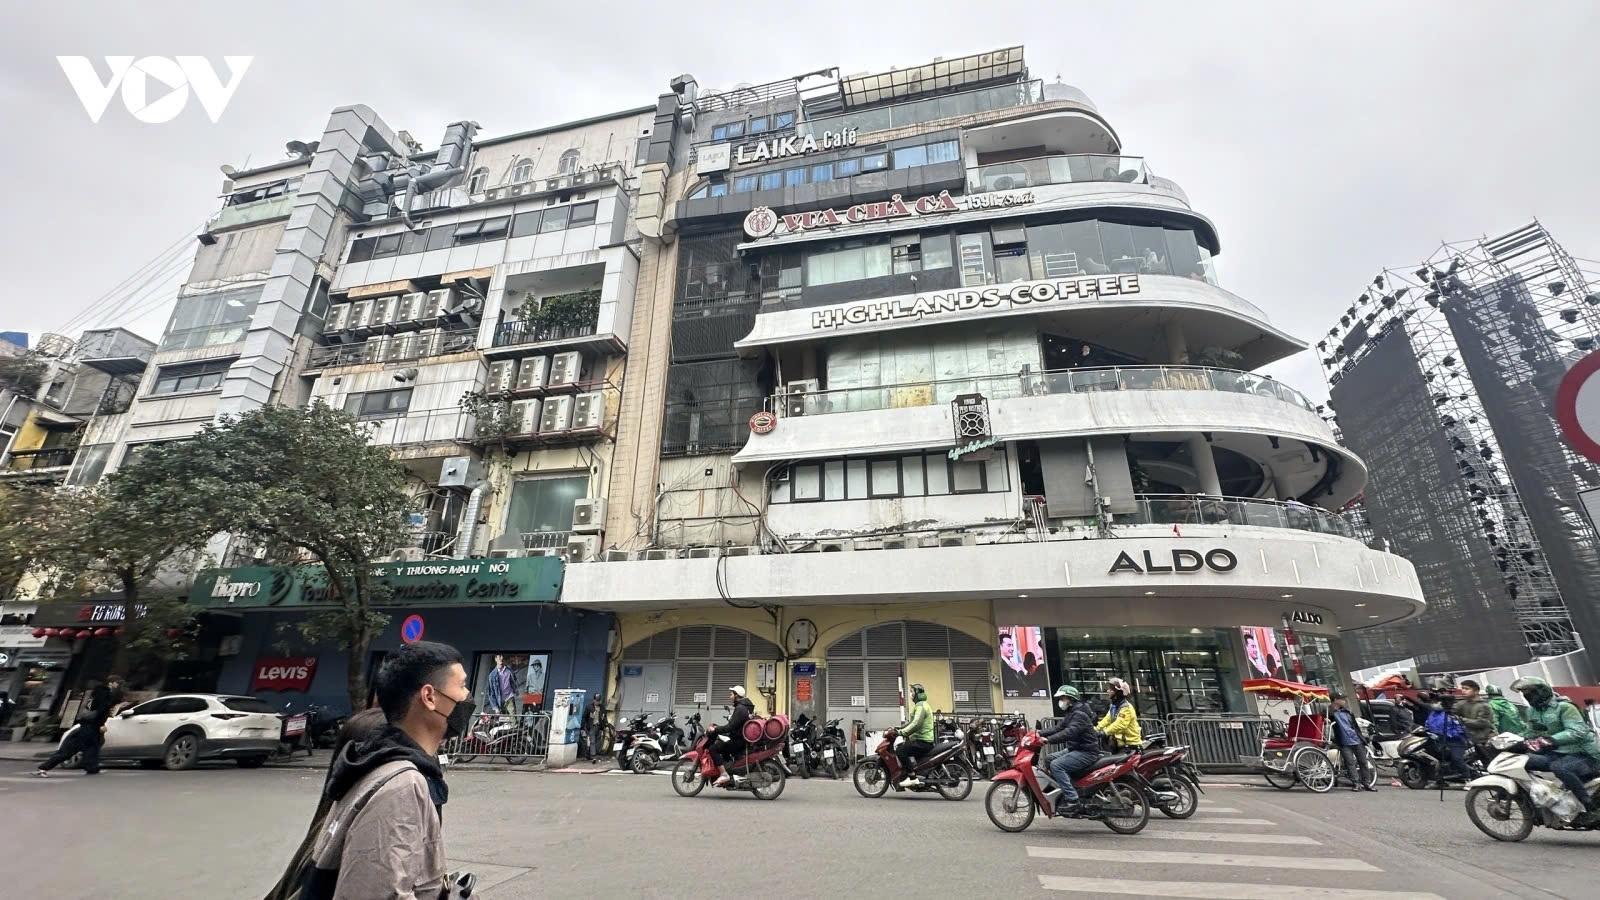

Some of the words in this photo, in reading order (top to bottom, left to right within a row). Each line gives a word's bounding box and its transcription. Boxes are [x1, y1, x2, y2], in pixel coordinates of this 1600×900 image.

[737, 133, 819, 165] LAIKA
[823, 126, 859, 149] Café
[783, 207, 842, 232] VUA
[846, 193, 912, 222] CHẢ
[915, 189, 960, 214] CÁ
[811, 288, 1002, 329] HIGHLANDS
[1010, 275, 1141, 304] COFFEE
[489, 560, 510, 576] NỘI
[1107, 548, 1238, 575] ALDO
[1291, 610, 1324, 626] ALDO
